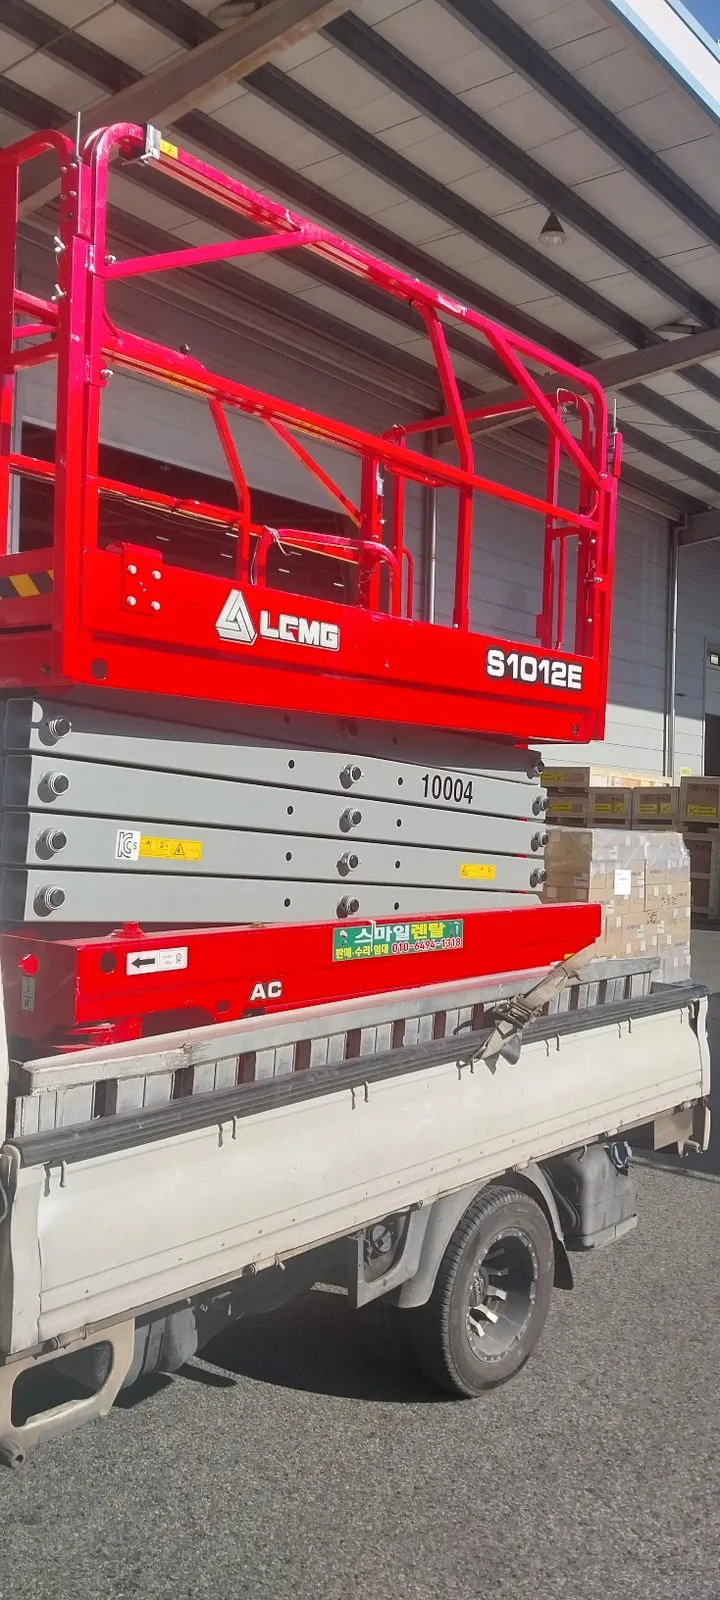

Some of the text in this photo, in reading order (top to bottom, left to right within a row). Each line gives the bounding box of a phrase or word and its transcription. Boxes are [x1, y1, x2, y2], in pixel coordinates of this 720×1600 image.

[486, 648, 583, 690] S1012E
[421, 773, 474, 805] 10004
[354, 922, 446, 944] 스마일렌탈
[391, 936, 462, 954] 010-6494-1318
[249, 980, 283, 1002] AC
